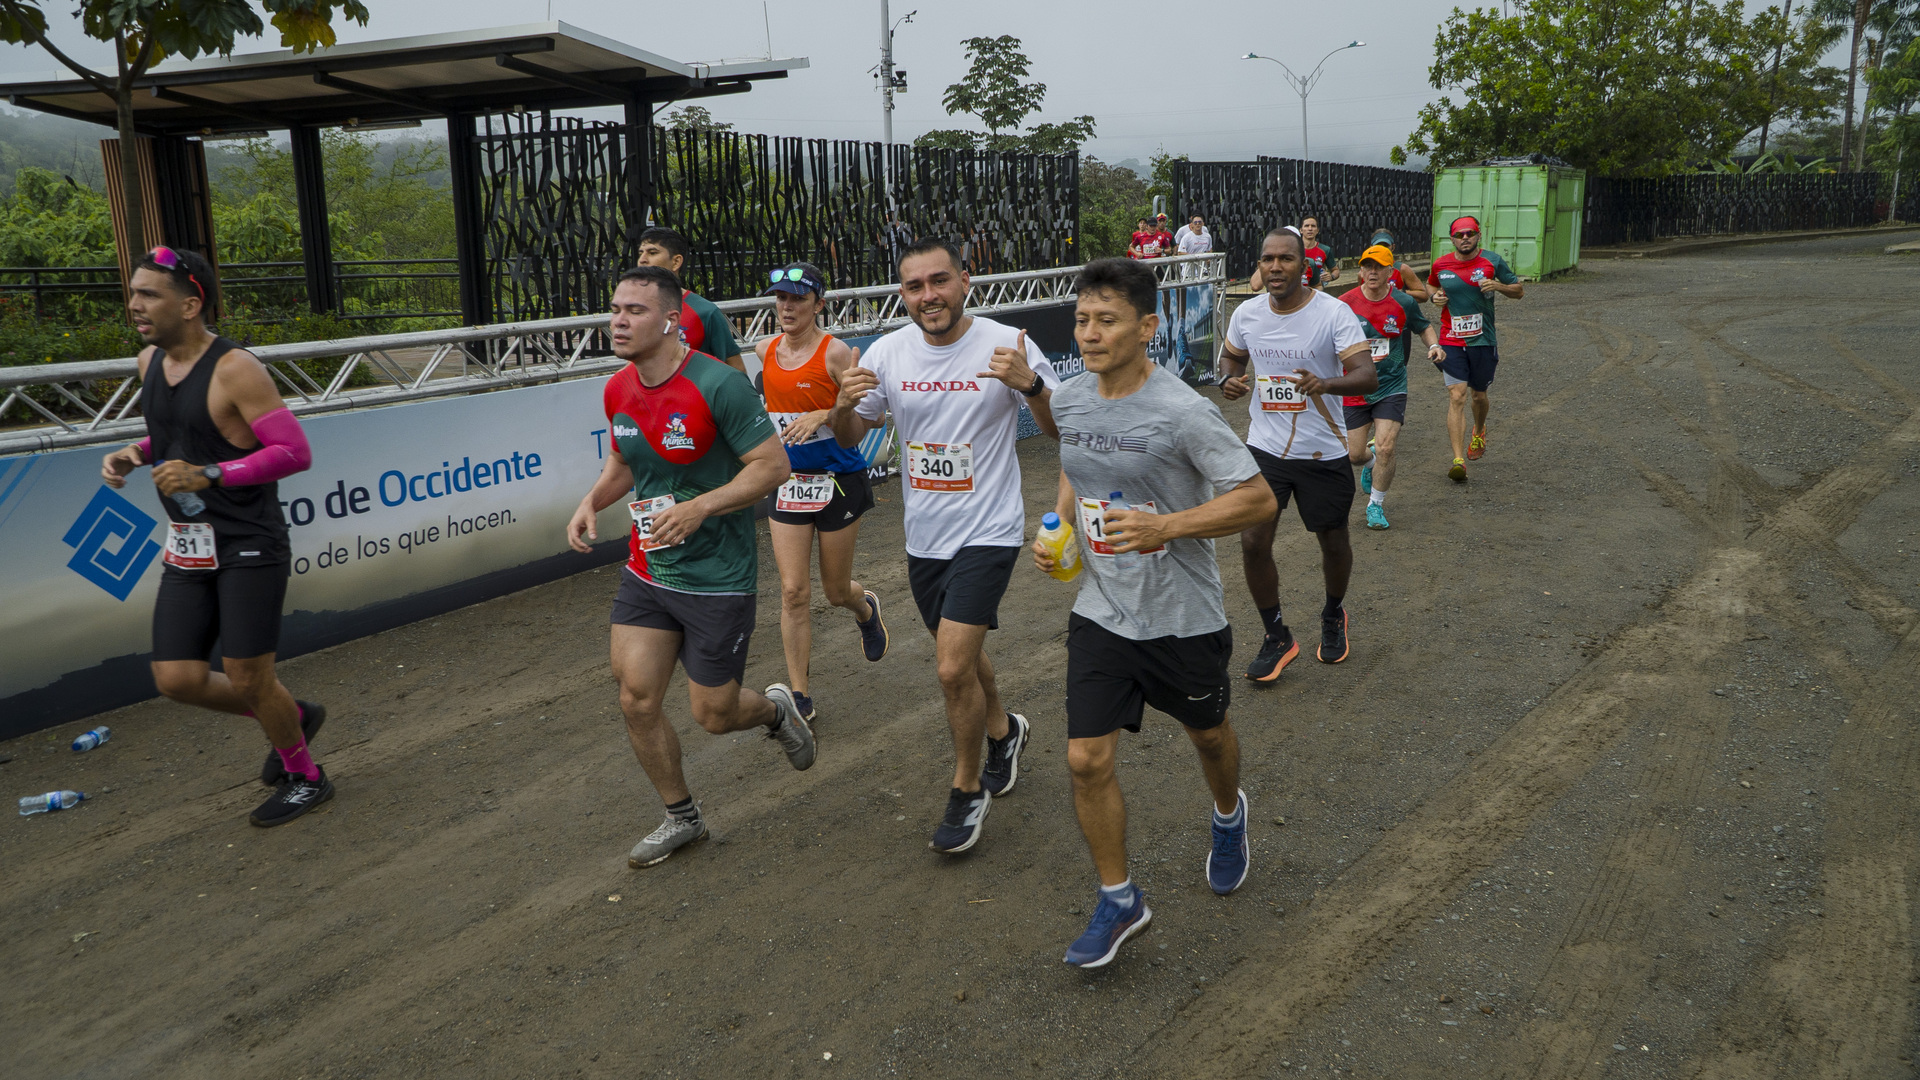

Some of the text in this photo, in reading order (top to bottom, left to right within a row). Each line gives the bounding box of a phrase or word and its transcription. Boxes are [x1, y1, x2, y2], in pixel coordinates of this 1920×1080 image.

[1457, 321, 1478, 331] 1471
[901, 381, 981, 392] HONDA
[1266, 387, 1293, 400] 166
[1094, 434, 1121, 450] RUN
[921, 458, 953, 477] 340
[325, 480, 370, 519] de
[379, 451, 542, 507] Occidente
[789, 485, 823, 500] 1047
[317, 542, 348, 569] de
[357, 535, 390, 560] los
[398, 526, 440, 554] que
[447, 509, 517, 538] hacen.
